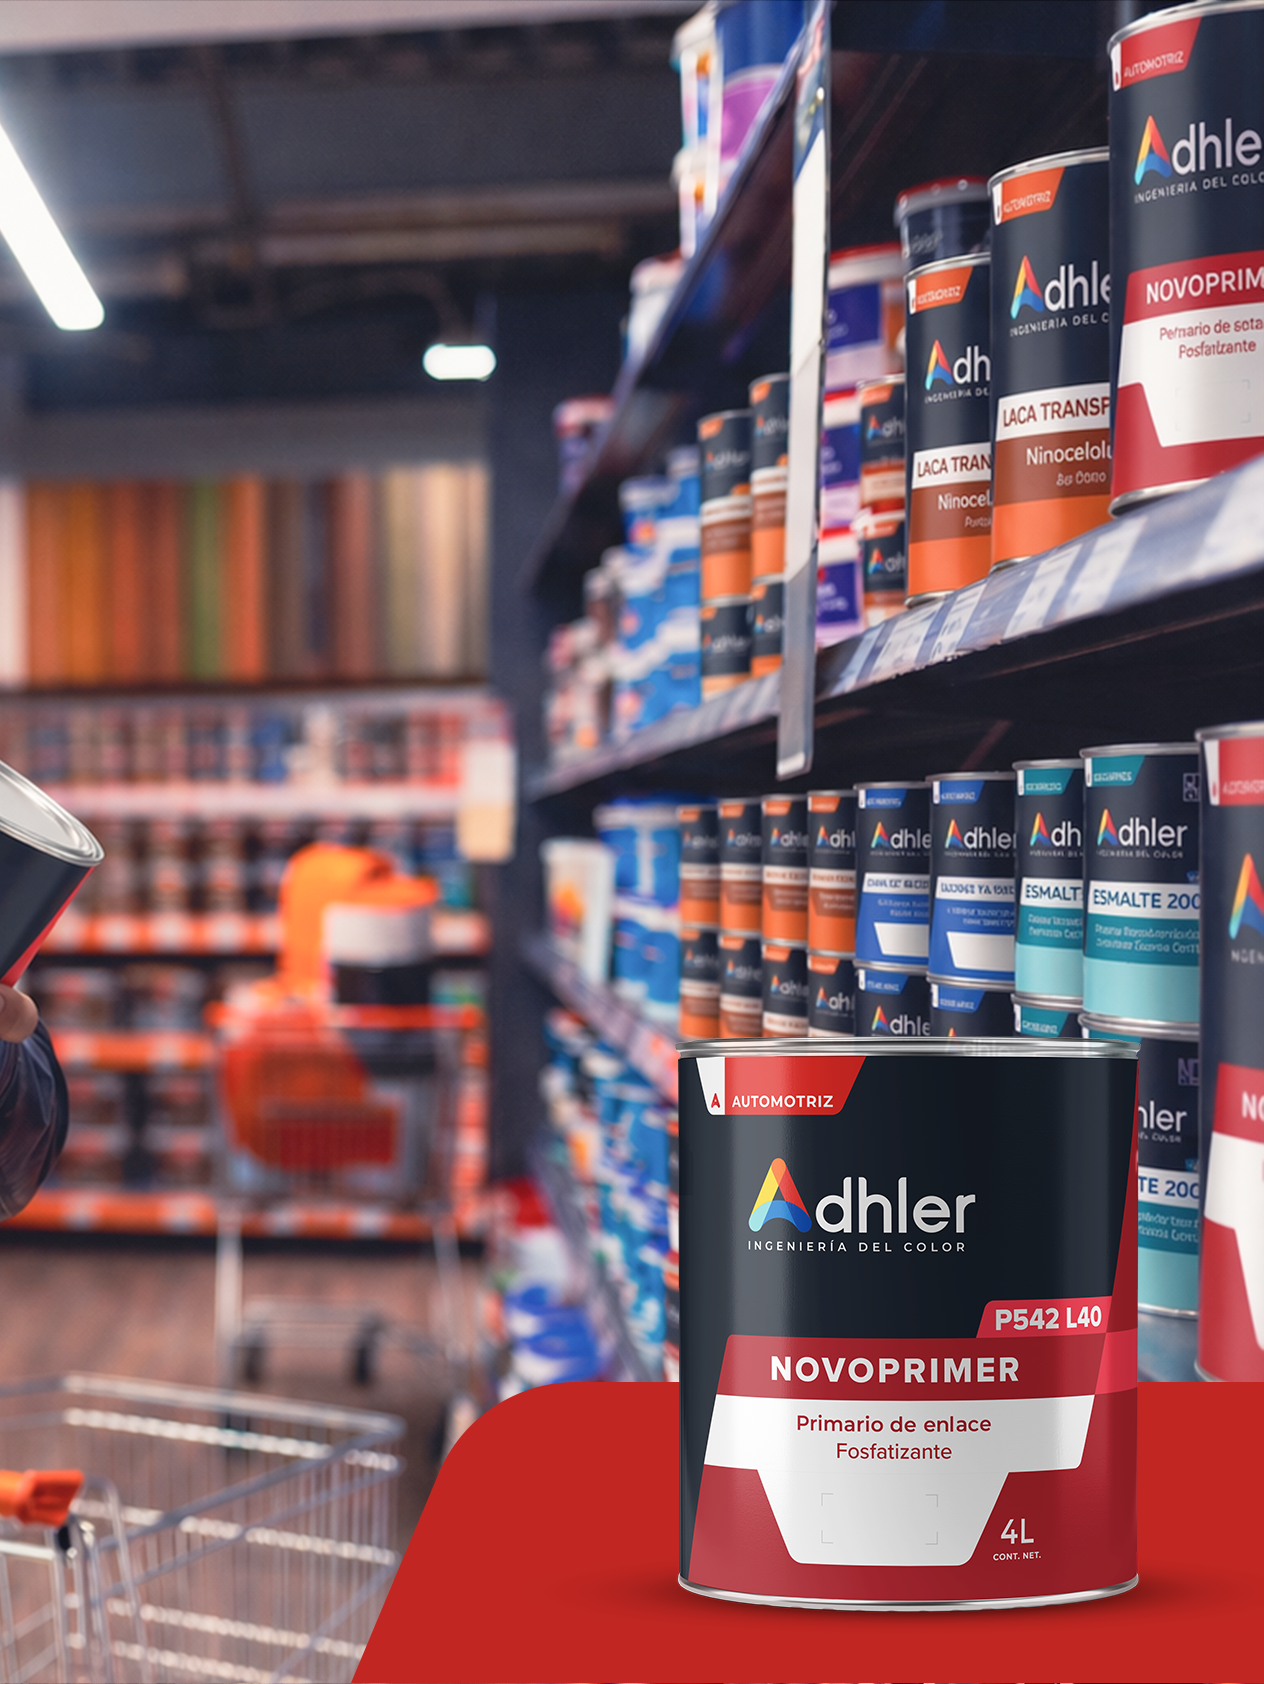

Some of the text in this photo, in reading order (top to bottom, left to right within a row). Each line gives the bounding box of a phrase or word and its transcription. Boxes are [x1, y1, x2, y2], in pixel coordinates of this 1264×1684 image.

[1202, 176, 1227, 190] DEL
[1214, 319, 1231, 334] de
[1003, 404, 1038, 428] LACA
[917, 458, 949, 478] LACA
[1030, 812, 1082, 847] Adh
[1097, 808, 1189, 848] Adhler
[1093, 888, 1162, 909] ESMALTE
[731, 1094, 834, 1109] AUTOMOTRIZ
[748, 1157, 976, 1234] Adhler
[748, 1239, 965, 1252] INGENIERÍA DEL COLOR
[995, 1305, 1102, 1331] P542 L40
[770, 1355, 1019, 1383] NOVOPRIMER
[796, 1414, 992, 1433] Primario de enlace
[836, 1442, 952, 1460] Fosfatizante
[1000, 1518, 1034, 1545] 4L
[993, 1550, 1042, 1561] CONT. NET.
